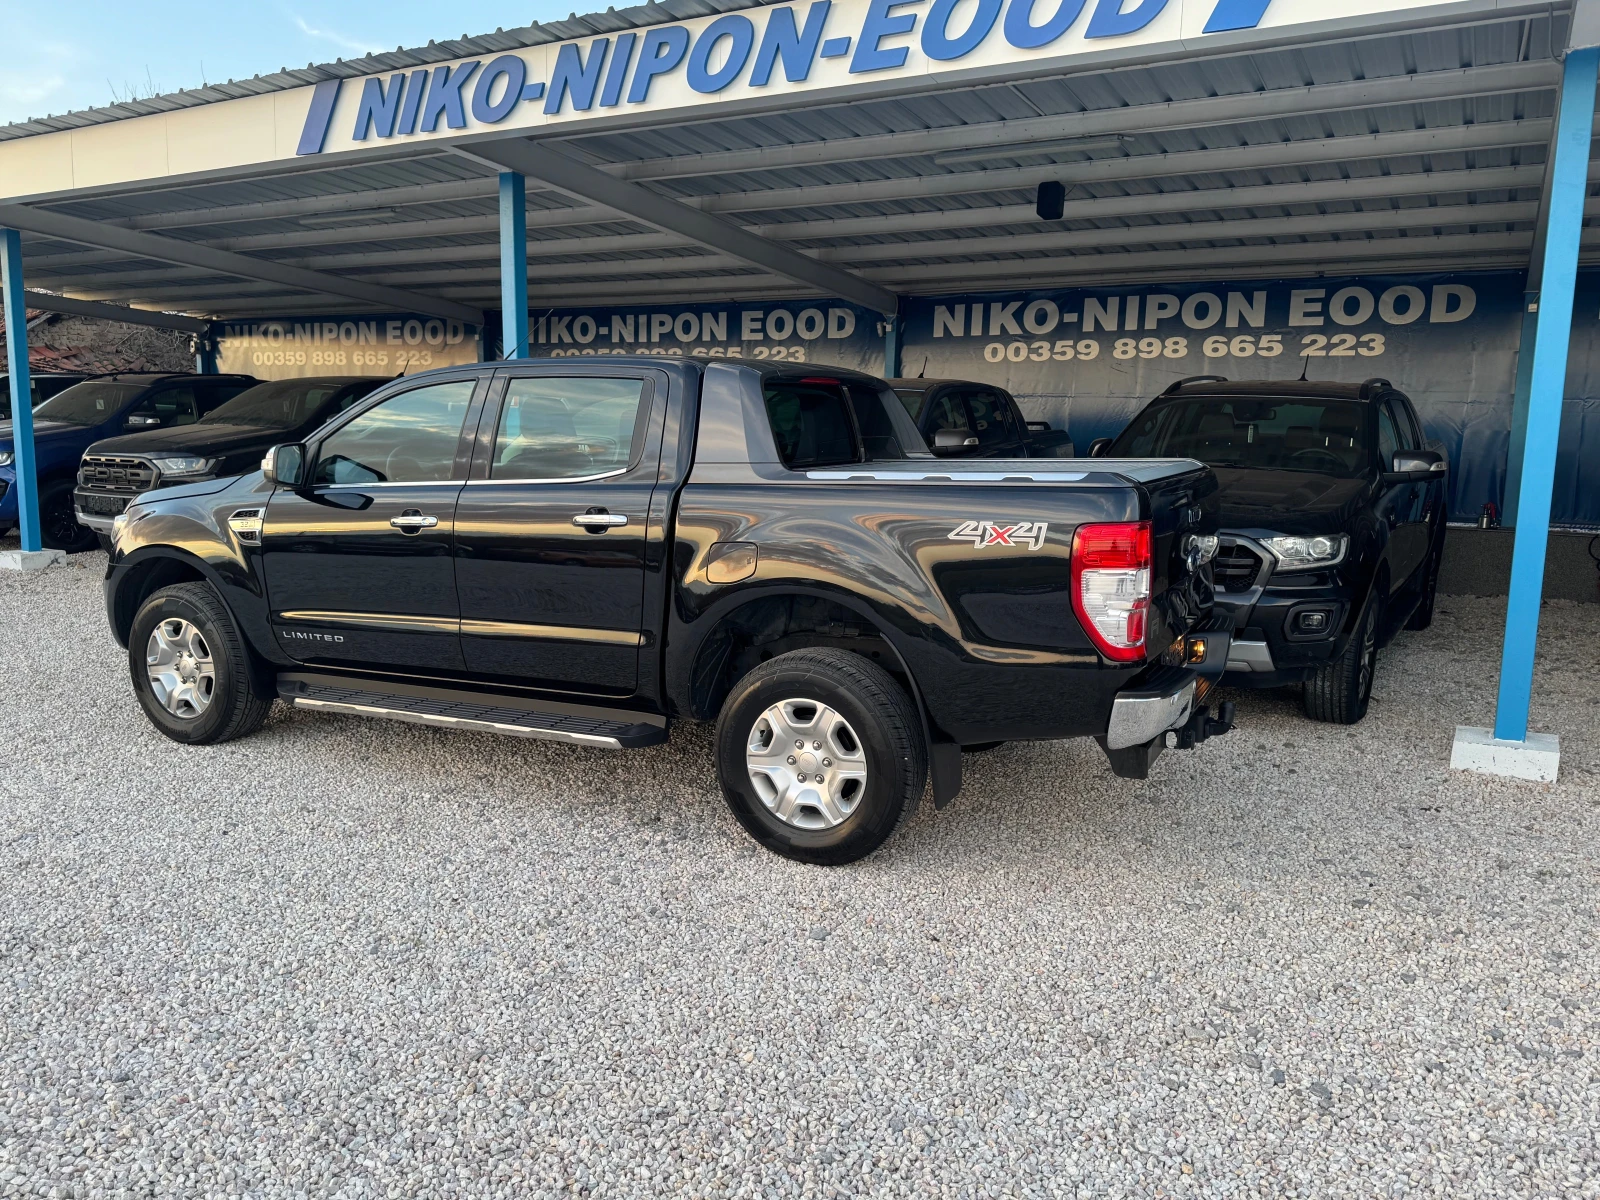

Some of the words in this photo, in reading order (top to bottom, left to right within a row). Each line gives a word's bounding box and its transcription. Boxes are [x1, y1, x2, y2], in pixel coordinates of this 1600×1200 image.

[933, 291, 1267, 338] NIKO-NIPON
[1288, 284, 1477, 327] EOOD
[224, 320, 377, 348] NIKO-NIPON
[386, 319, 465, 346] EOOD
[528, 312, 727, 345] IKO-NIPON
[741, 308, 856, 341] EOOD
[253, 351, 306, 366] 00359
[312, 351, 347, 366] 898
[353, 350, 389, 366] 665
[395, 350, 433, 366] 223
[752, 345, 806, 363] 223
[983, 339, 1100, 363] 00359
[1112, 337, 1188, 360] 898
[1202, 334, 1284, 358] 665
[1300, 333, 1386, 357] 223
[83, 466, 145, 481] FORD
[282, 630, 345, 643] LIMITED
